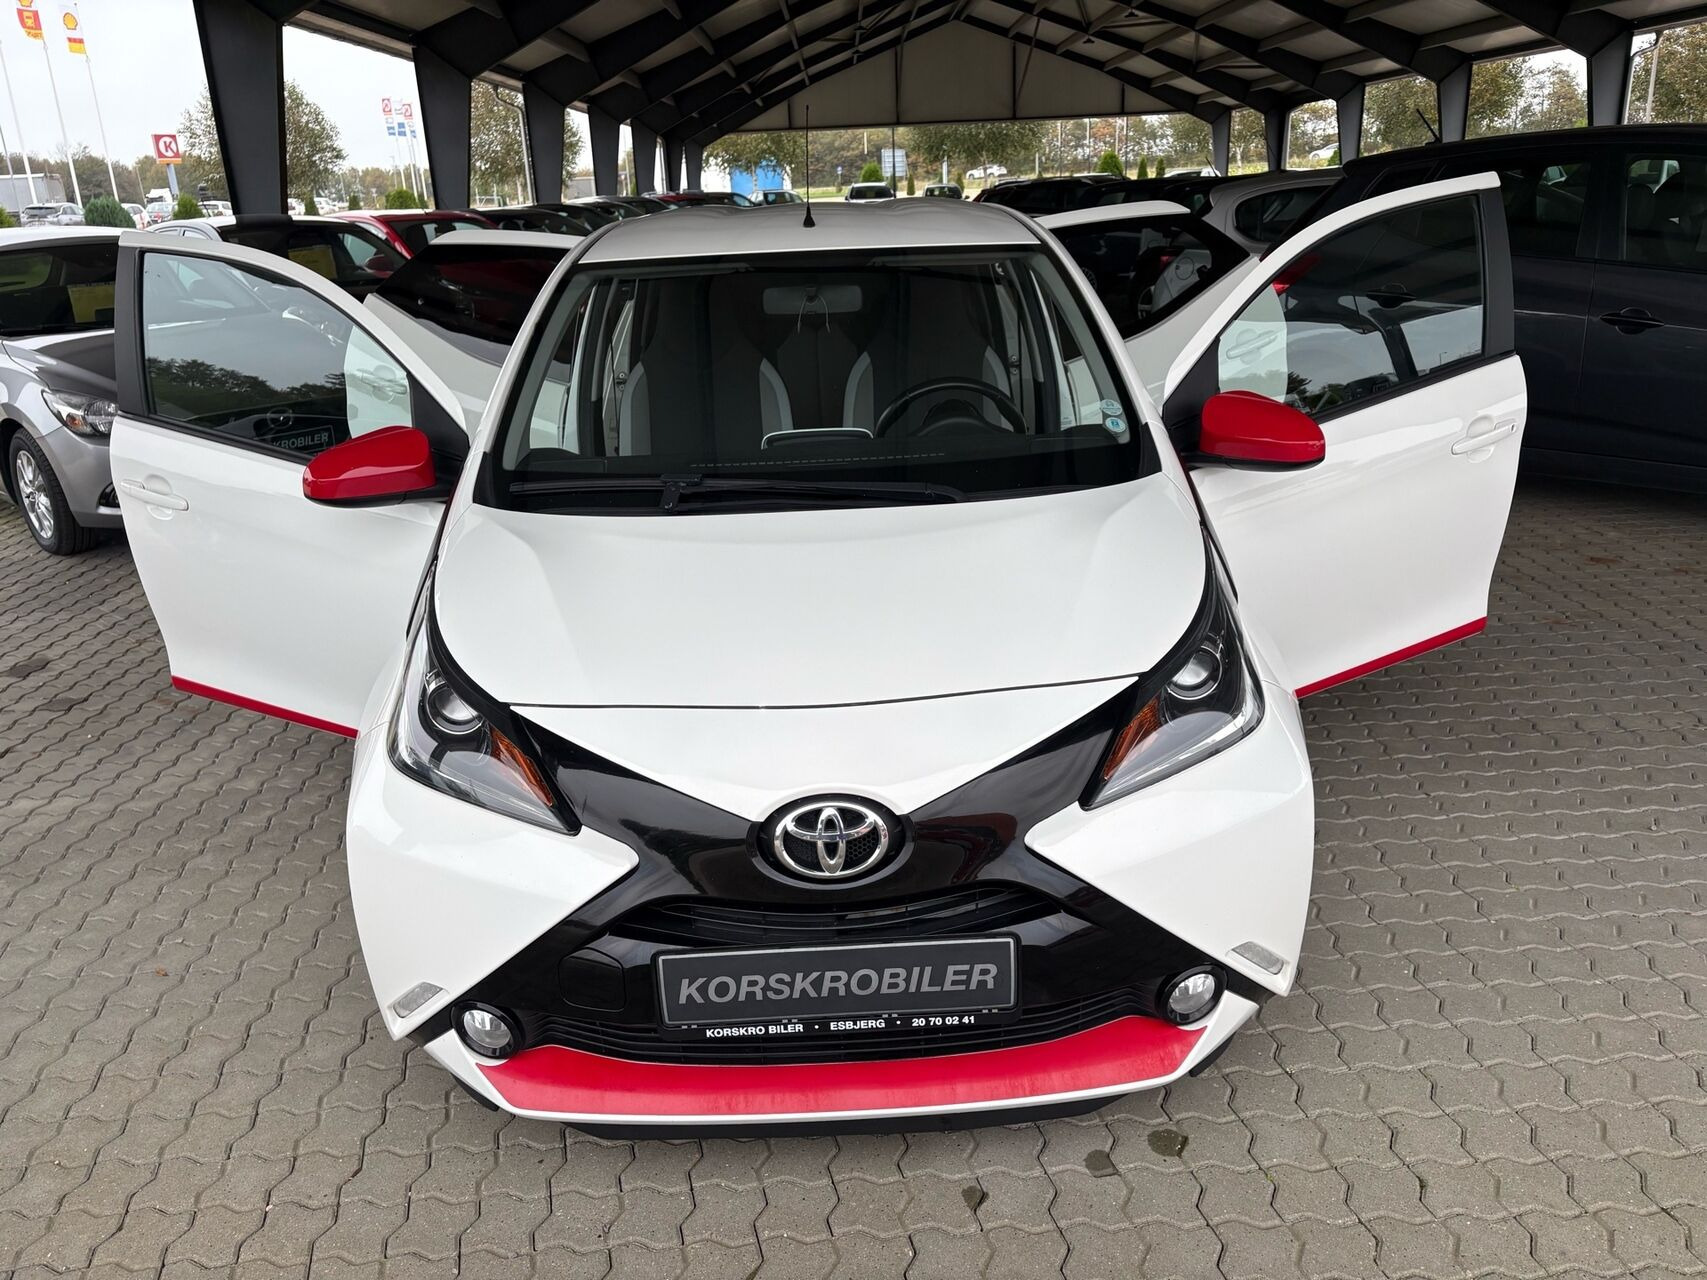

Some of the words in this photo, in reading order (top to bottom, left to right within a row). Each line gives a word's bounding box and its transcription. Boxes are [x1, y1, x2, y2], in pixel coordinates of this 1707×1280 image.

[163, 141, 175, 154] K
[678, 963, 998, 1005] KORSKROBILER
[706, 1026, 766, 1038] KORSKRO
[768, 1023, 804, 1034] BILER
[830, 1019, 886, 1031] ESBJERG
[912, 1017, 926, 1027] 20
[929, 1017, 943, 1026] 70
[945, 1016, 959, 1025] 02
[962, 1015, 975, 1024] 41
